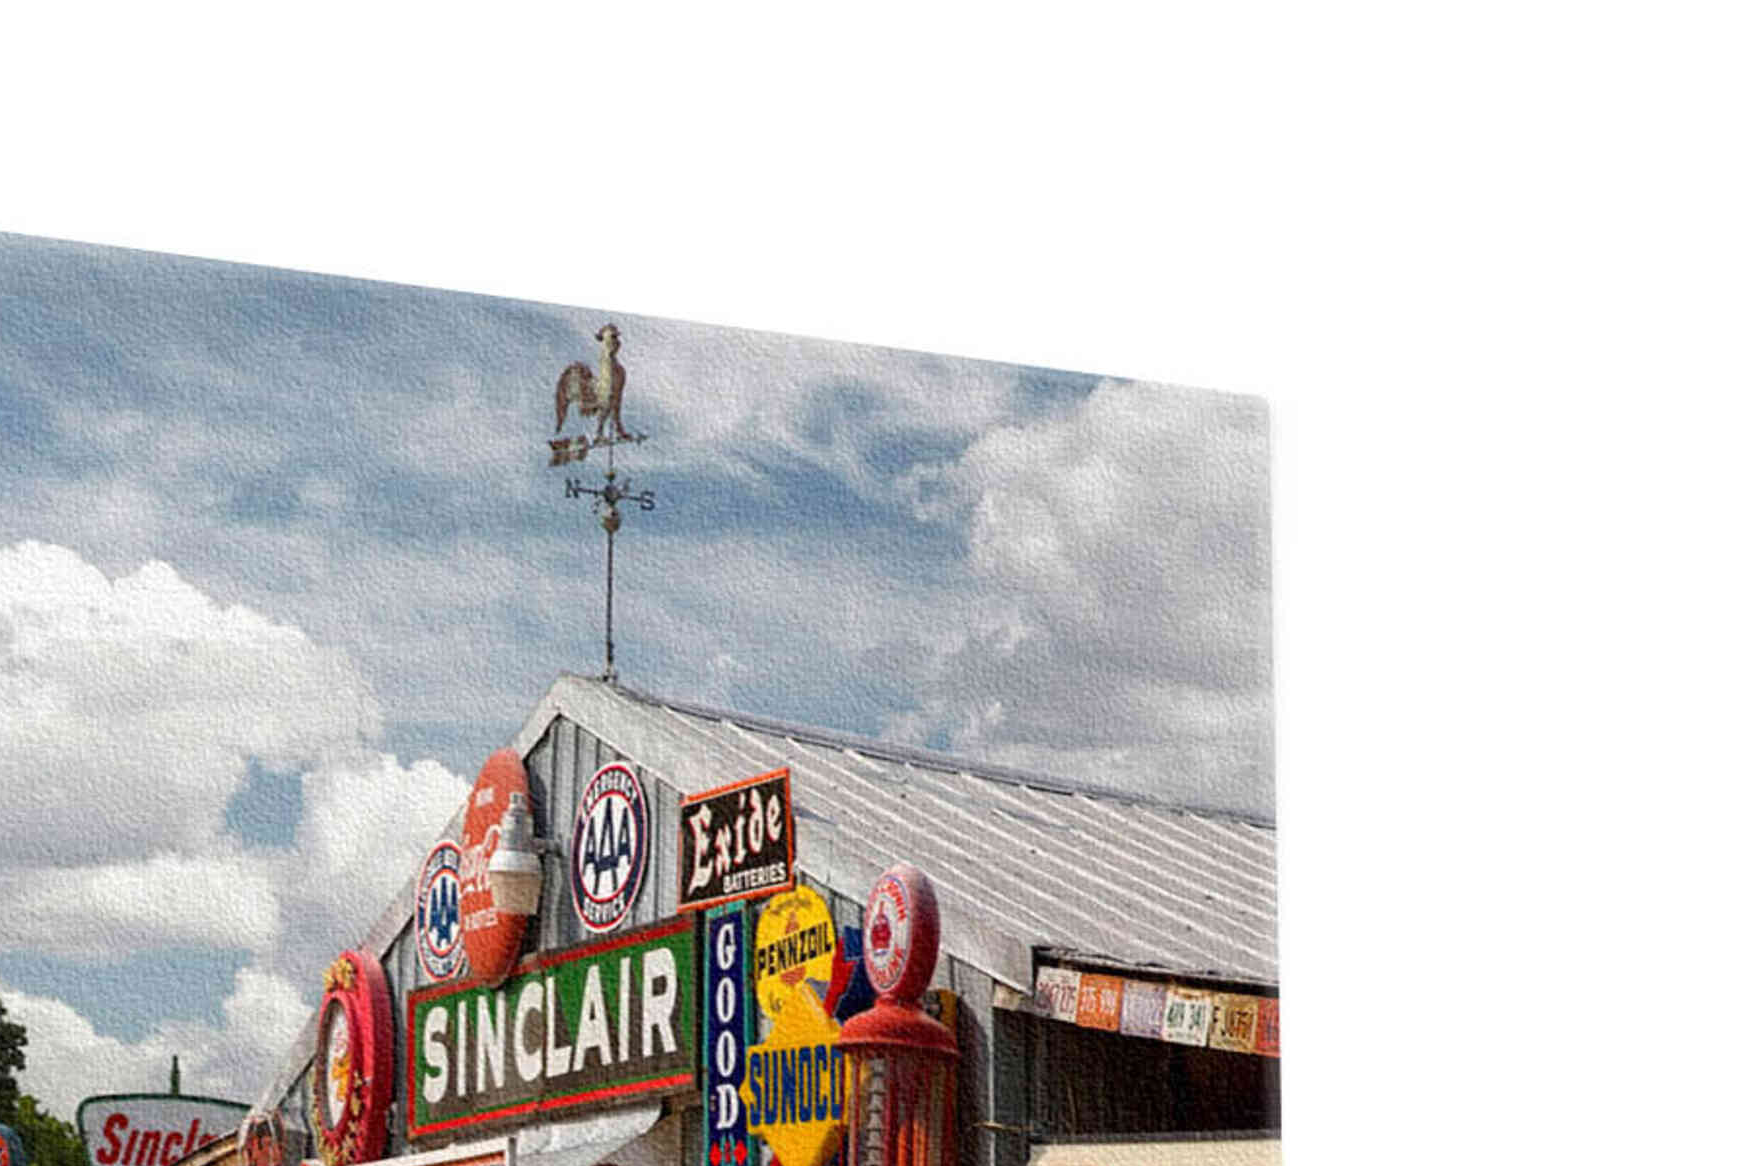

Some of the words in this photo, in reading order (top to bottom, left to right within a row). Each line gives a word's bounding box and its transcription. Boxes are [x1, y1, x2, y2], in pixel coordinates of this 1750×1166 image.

[583, 797, 632, 895] AAA
[687, 787, 783, 897] Exide
[723, 862, 787, 894] BATTERIES
[757, 920, 833, 980] PENNZOIL
[422, 945, 680, 1106] SINCLAIR
[748, 1044, 843, 1128] SUNOCO
